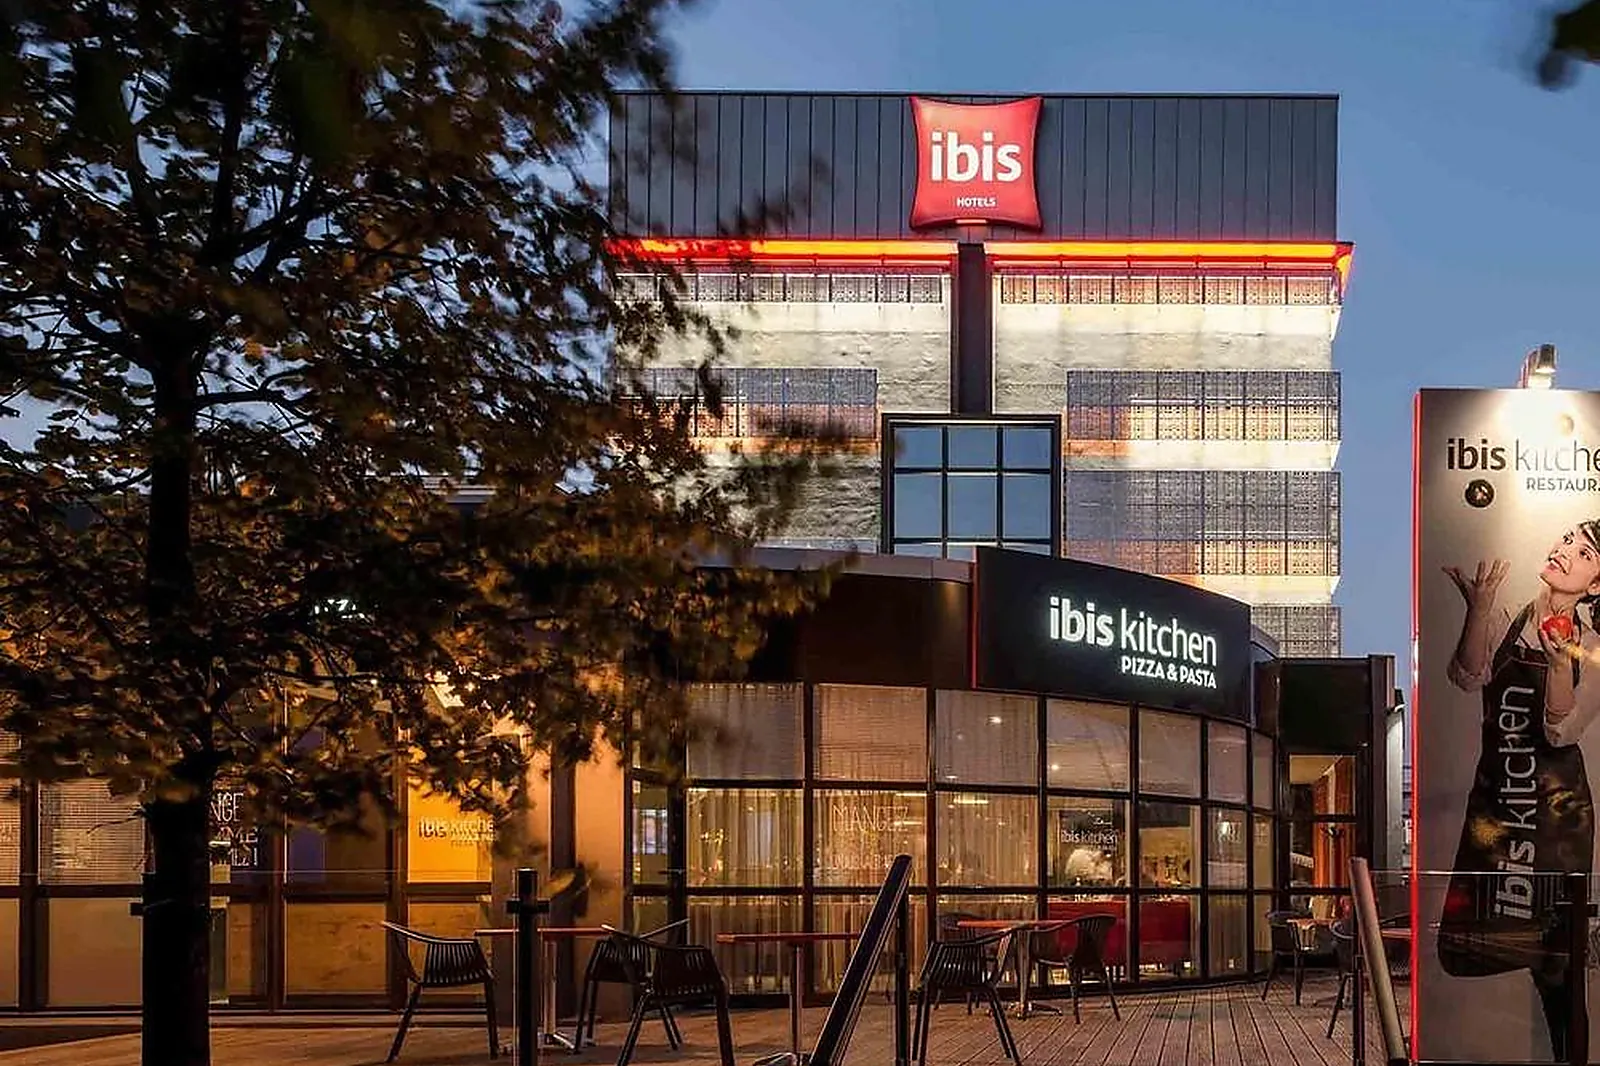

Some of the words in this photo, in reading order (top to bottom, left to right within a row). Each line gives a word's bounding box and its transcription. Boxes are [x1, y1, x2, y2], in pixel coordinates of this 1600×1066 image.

[931, 130, 1022, 182] ibis
[956, 197, 997, 208] HOTELS
[1447, 438, 1506, 470] ibis
[1526, 477, 1600, 491] RESTAUR
[1050, 596, 1115, 647] ibis
[1121, 608, 1217, 666] kitchen
[1121, 656, 1165, 679] PIZZA
[1167, 663, 1178, 682] &
[1179, 665, 1217, 689] PASTA
[1499, 685, 1537, 830] kitchen
[1061, 830, 1080, 843] ibis
[1495, 840, 1535, 919] ibis
